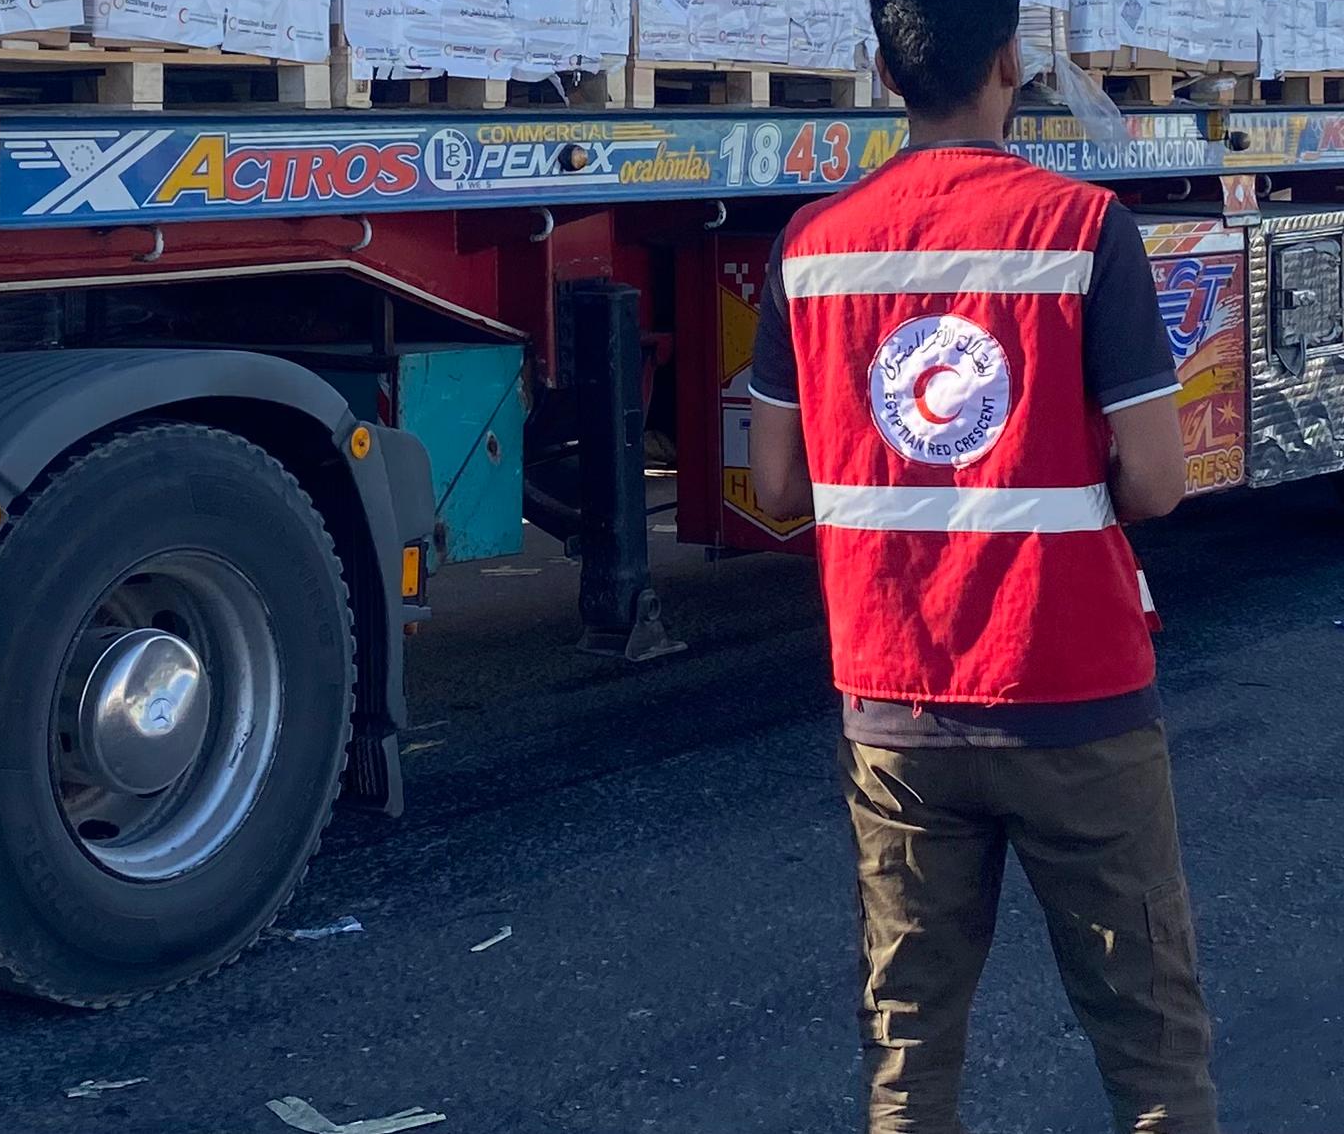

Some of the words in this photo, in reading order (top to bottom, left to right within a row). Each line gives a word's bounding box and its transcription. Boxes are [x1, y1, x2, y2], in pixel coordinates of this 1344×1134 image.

[473, 142, 616, 179] PEMX
[476, 123, 613, 145] COMMERCIAL
[719, 121, 850, 188] 1843
[146, 132, 422, 207] ACTROS
[884, 391, 925, 452] EGYPTIAN
[927, 442, 951, 456] RED
[954, 396, 996, 454] CRESCENT
